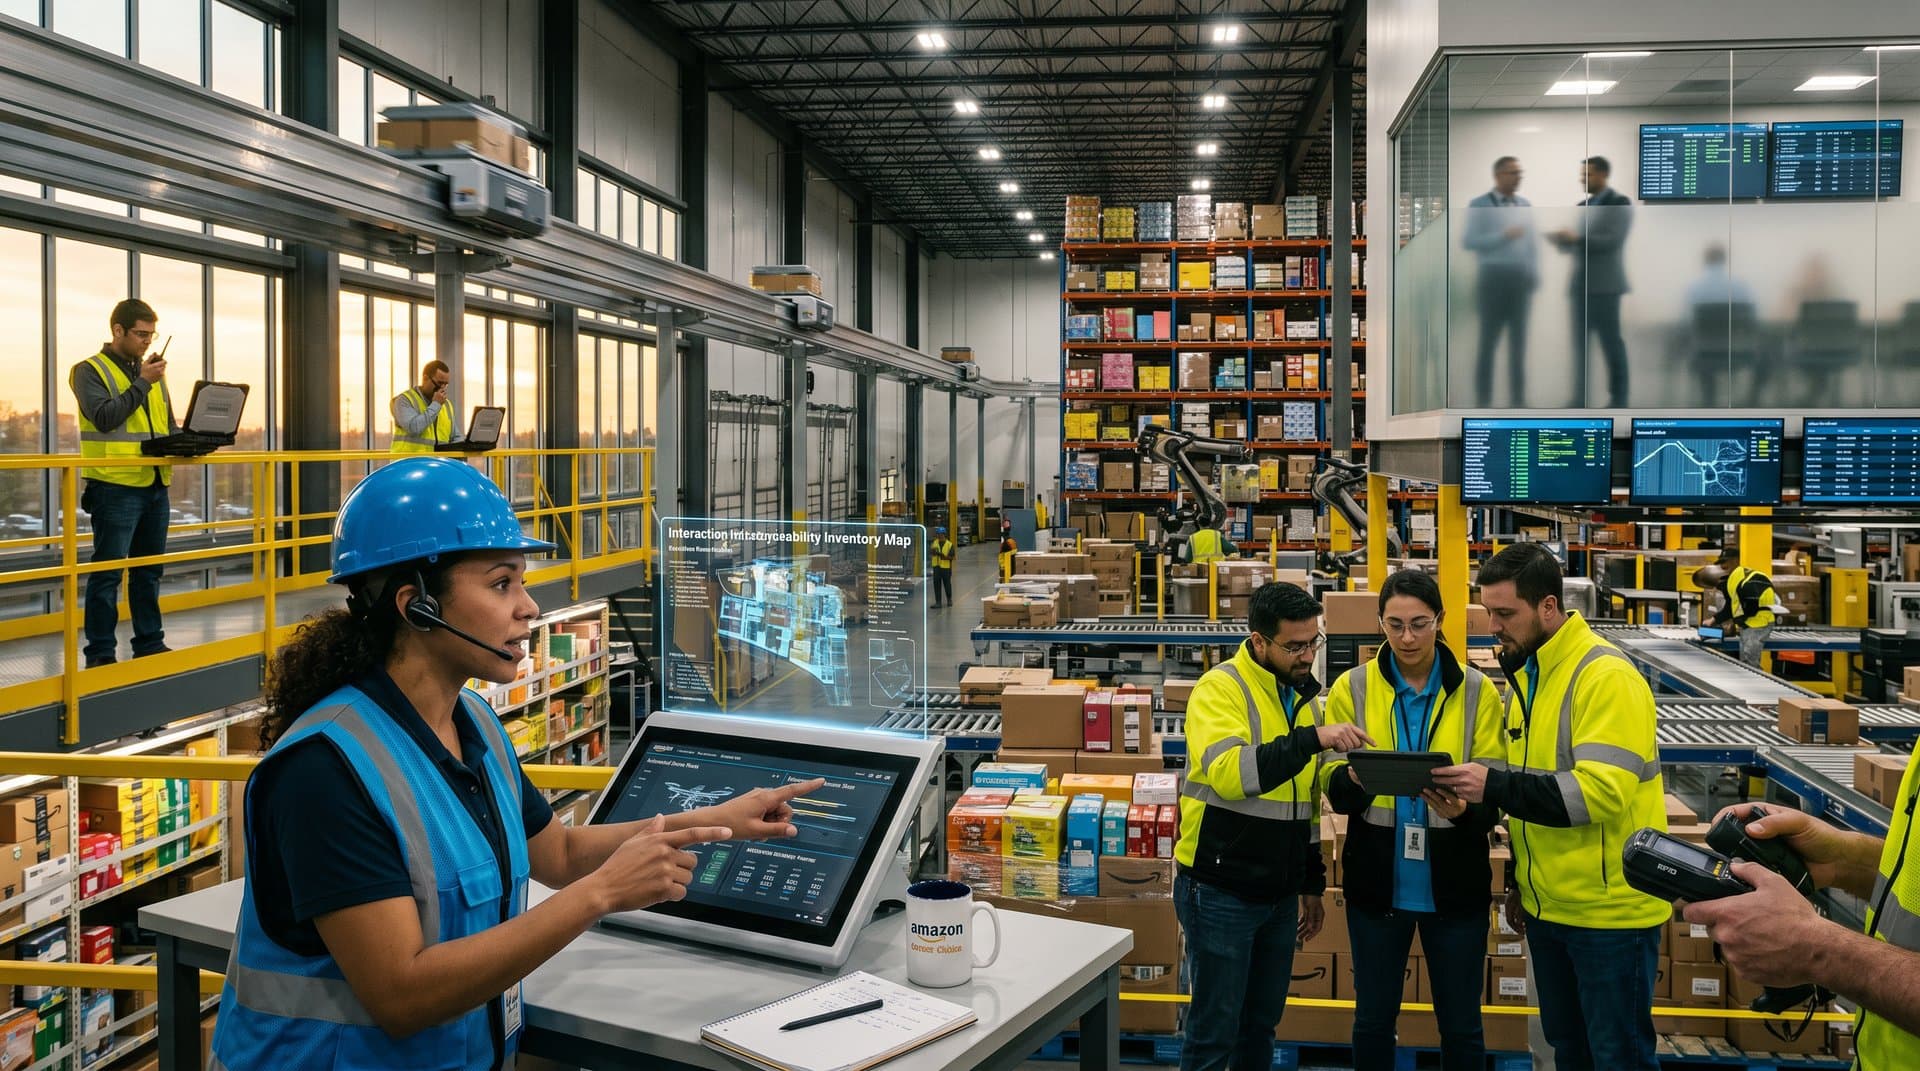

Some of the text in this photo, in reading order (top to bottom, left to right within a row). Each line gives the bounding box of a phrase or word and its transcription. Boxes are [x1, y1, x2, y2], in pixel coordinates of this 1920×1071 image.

[668, 527, 728, 540] Interaction
[824, 532, 881, 548] Inventory
[884, 533, 911, 549] Map
[911, 922, 963, 937] amazon
